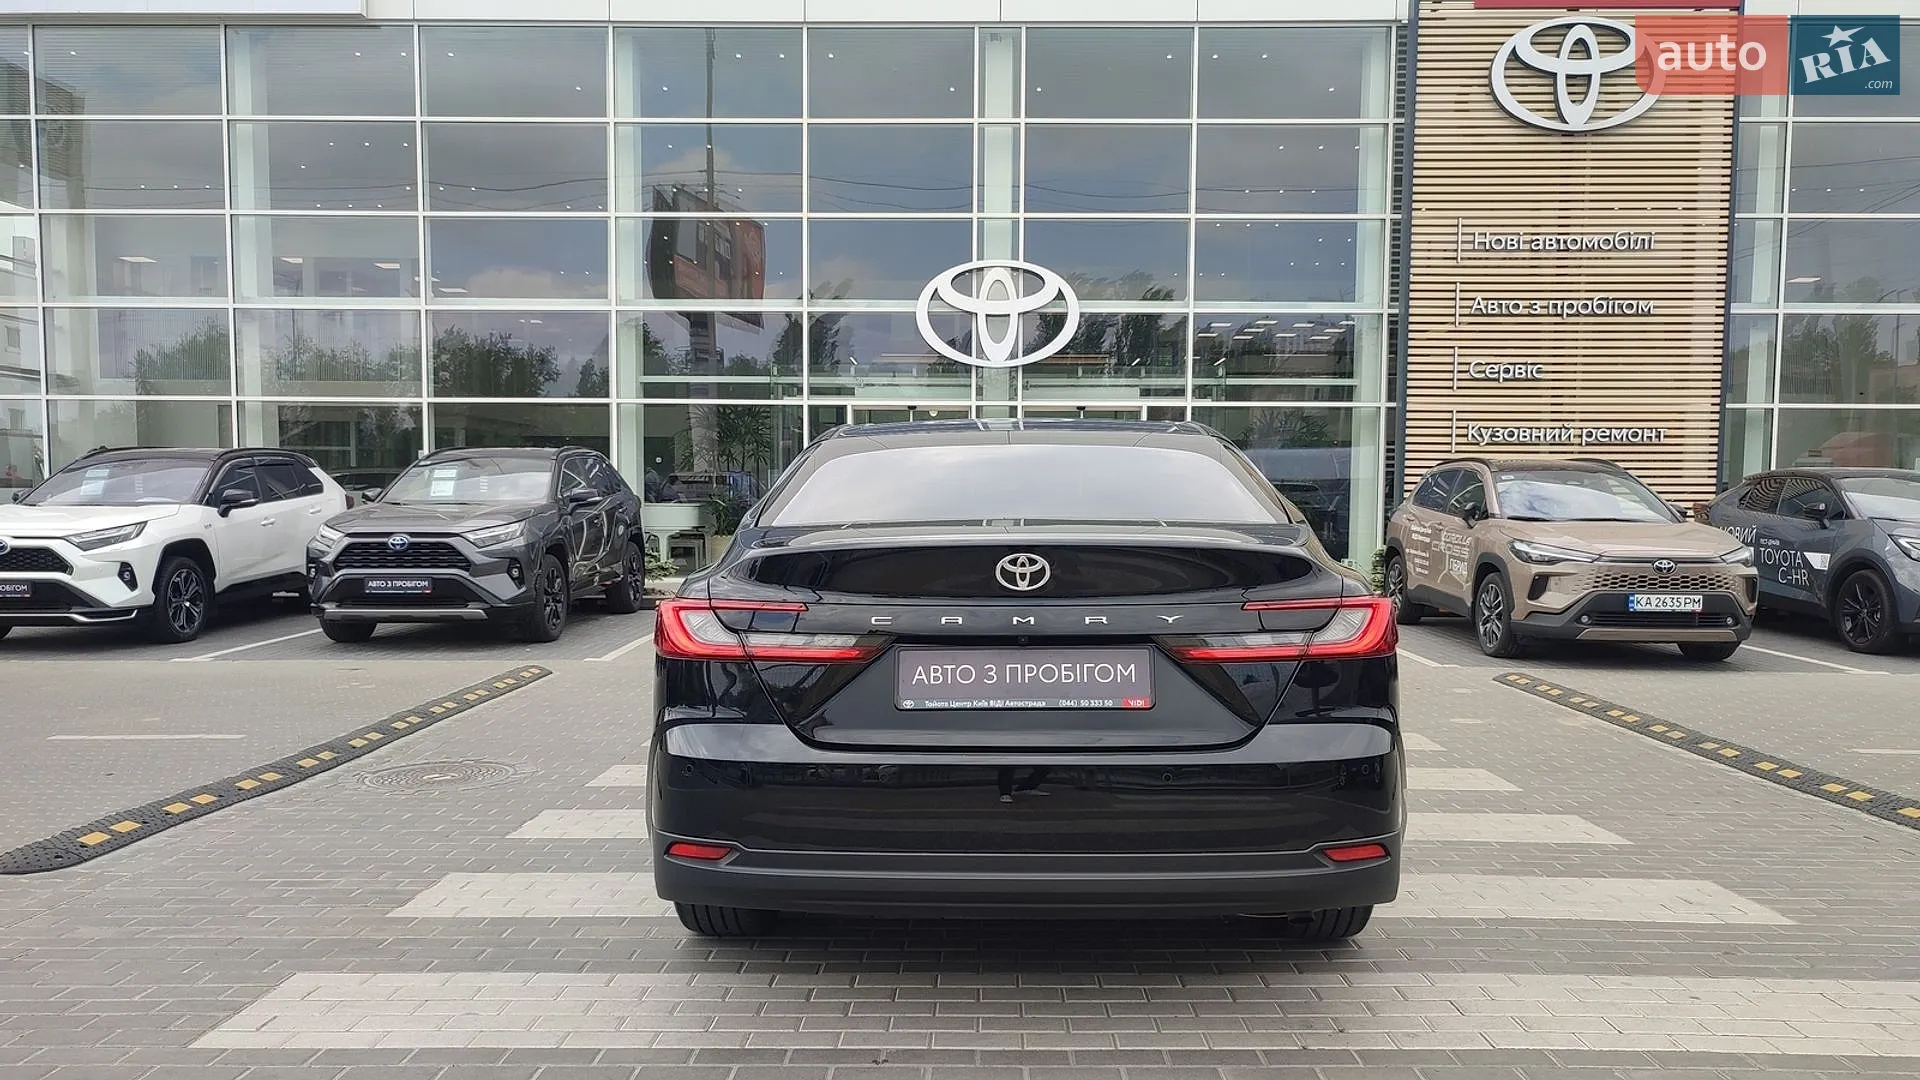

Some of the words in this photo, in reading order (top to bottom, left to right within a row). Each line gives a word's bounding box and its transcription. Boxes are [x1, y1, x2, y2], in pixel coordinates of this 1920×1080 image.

[1473, 231, 1523, 250] Нові
[1530, 231, 1656, 251] автомобілі
[1470, 295, 1523, 315] Авто
[1529, 300, 1541, 314] з
[1547, 296, 1655, 319] пробігом
[1468, 360, 1544, 383] Сервіс
[1467, 423, 1575, 446] Кузовний
[1580, 427, 1669, 446] ремонт
[1720, 523, 1758, 543] ОВИЙ
[1759, 547, 1804, 568] TOYOTA
[1778, 567, 1810, 586] C-HR
[1655, 596, 1682, 608] 2635
[871, 615, 1184, 625] CAMRY
[912, 665, 976, 685] АВТО
[1006, 663, 1136, 684] ПРОБІГОМ
